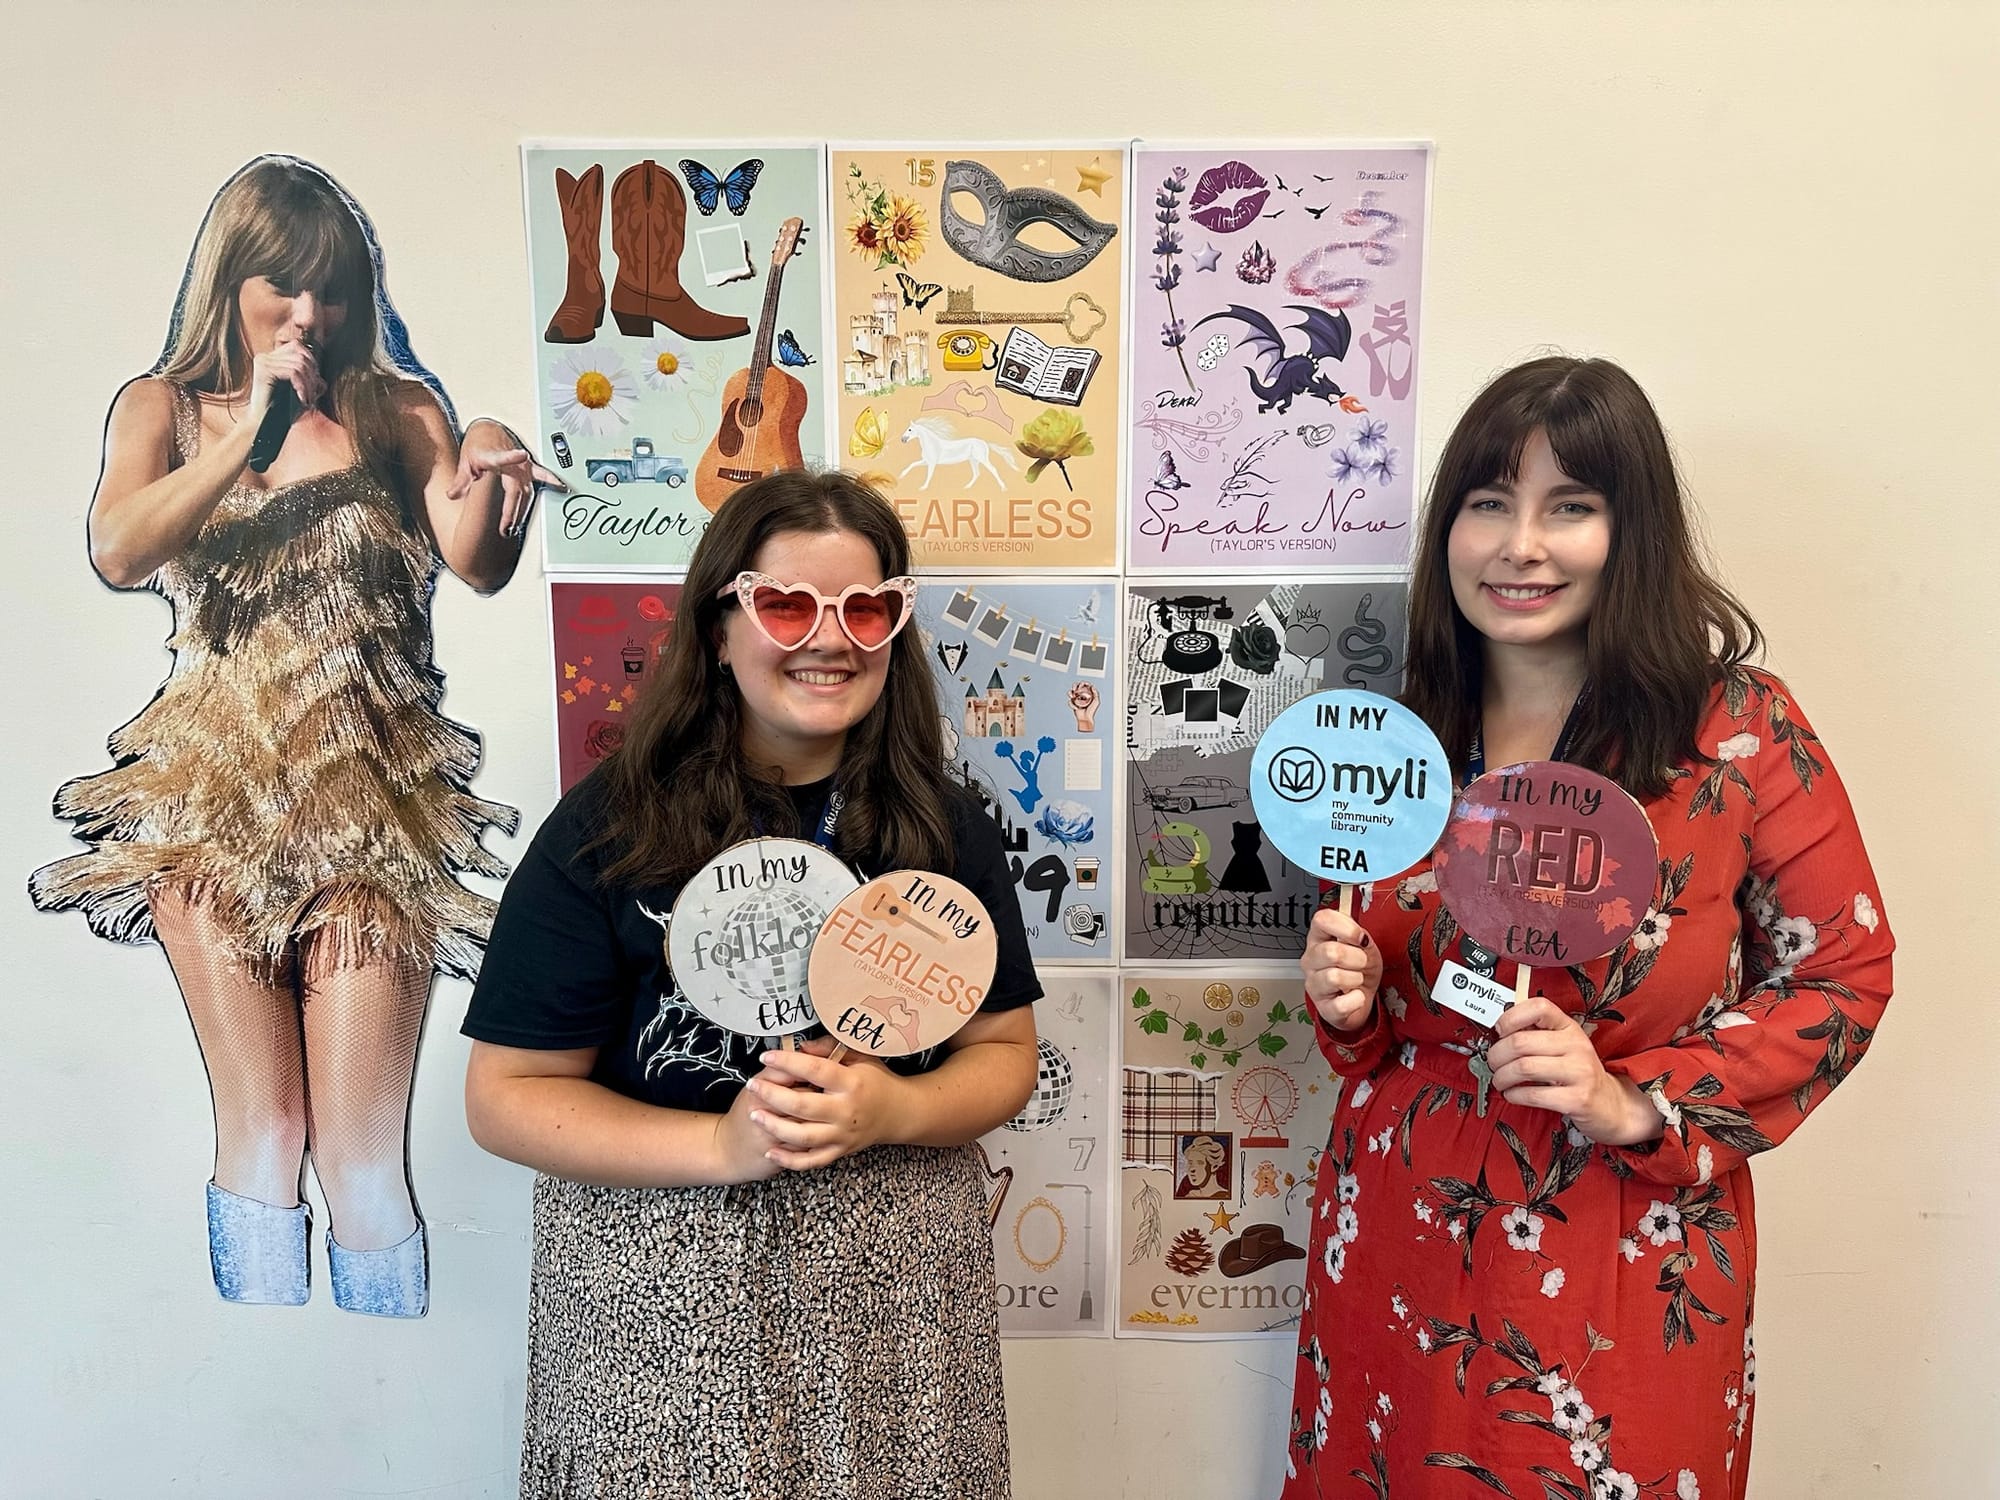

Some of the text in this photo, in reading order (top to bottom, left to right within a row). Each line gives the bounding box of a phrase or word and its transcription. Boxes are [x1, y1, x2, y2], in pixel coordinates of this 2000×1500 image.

[904, 158, 936, 187] 15
[563, 494, 695, 546] Taylor
[894, 499, 1092, 538] EARLESS
[1140, 488, 1407, 552] Speak Now
[923, 541, 1034, 554] (TAYLOR'S VERSION)
[1211, 538, 1336, 553] (TAYLOR'S VERSION)
[1316, 704, 1388, 731] IN MY
[1332, 758, 1427, 806] myli
[1498, 775, 1604, 816] In my
[1332, 801, 1349, 811] my
[1332, 811, 1394, 826] community
[1331, 820, 1367, 834] library
[712, 855, 811, 893] In my
[1321, 846, 1368, 873] ERA
[1488, 819, 1605, 895] RED
[901, 876, 980, 938] In my
[1153, 893, 1312, 938] reputati
[1546, 894, 1604, 912] VERSION)
[691, 916, 821, 972] folklo
[822, 907, 984, 1015] FEARLESS
[1472, 949, 1488, 963] HER
[1504, 924, 1568, 961] ERA
[853, 959, 930, 1007] (TAYLOR'S VERSION)
[1468, 981, 1496, 1001] myli
[756, 993, 815, 1030] ERA
[1465, 1000, 1486, 1014] Laura
[836, 1007, 885, 1049] ERA
[1069, 1137, 1095, 1171] 7
[1151, 1284, 1304, 1309] evermo
